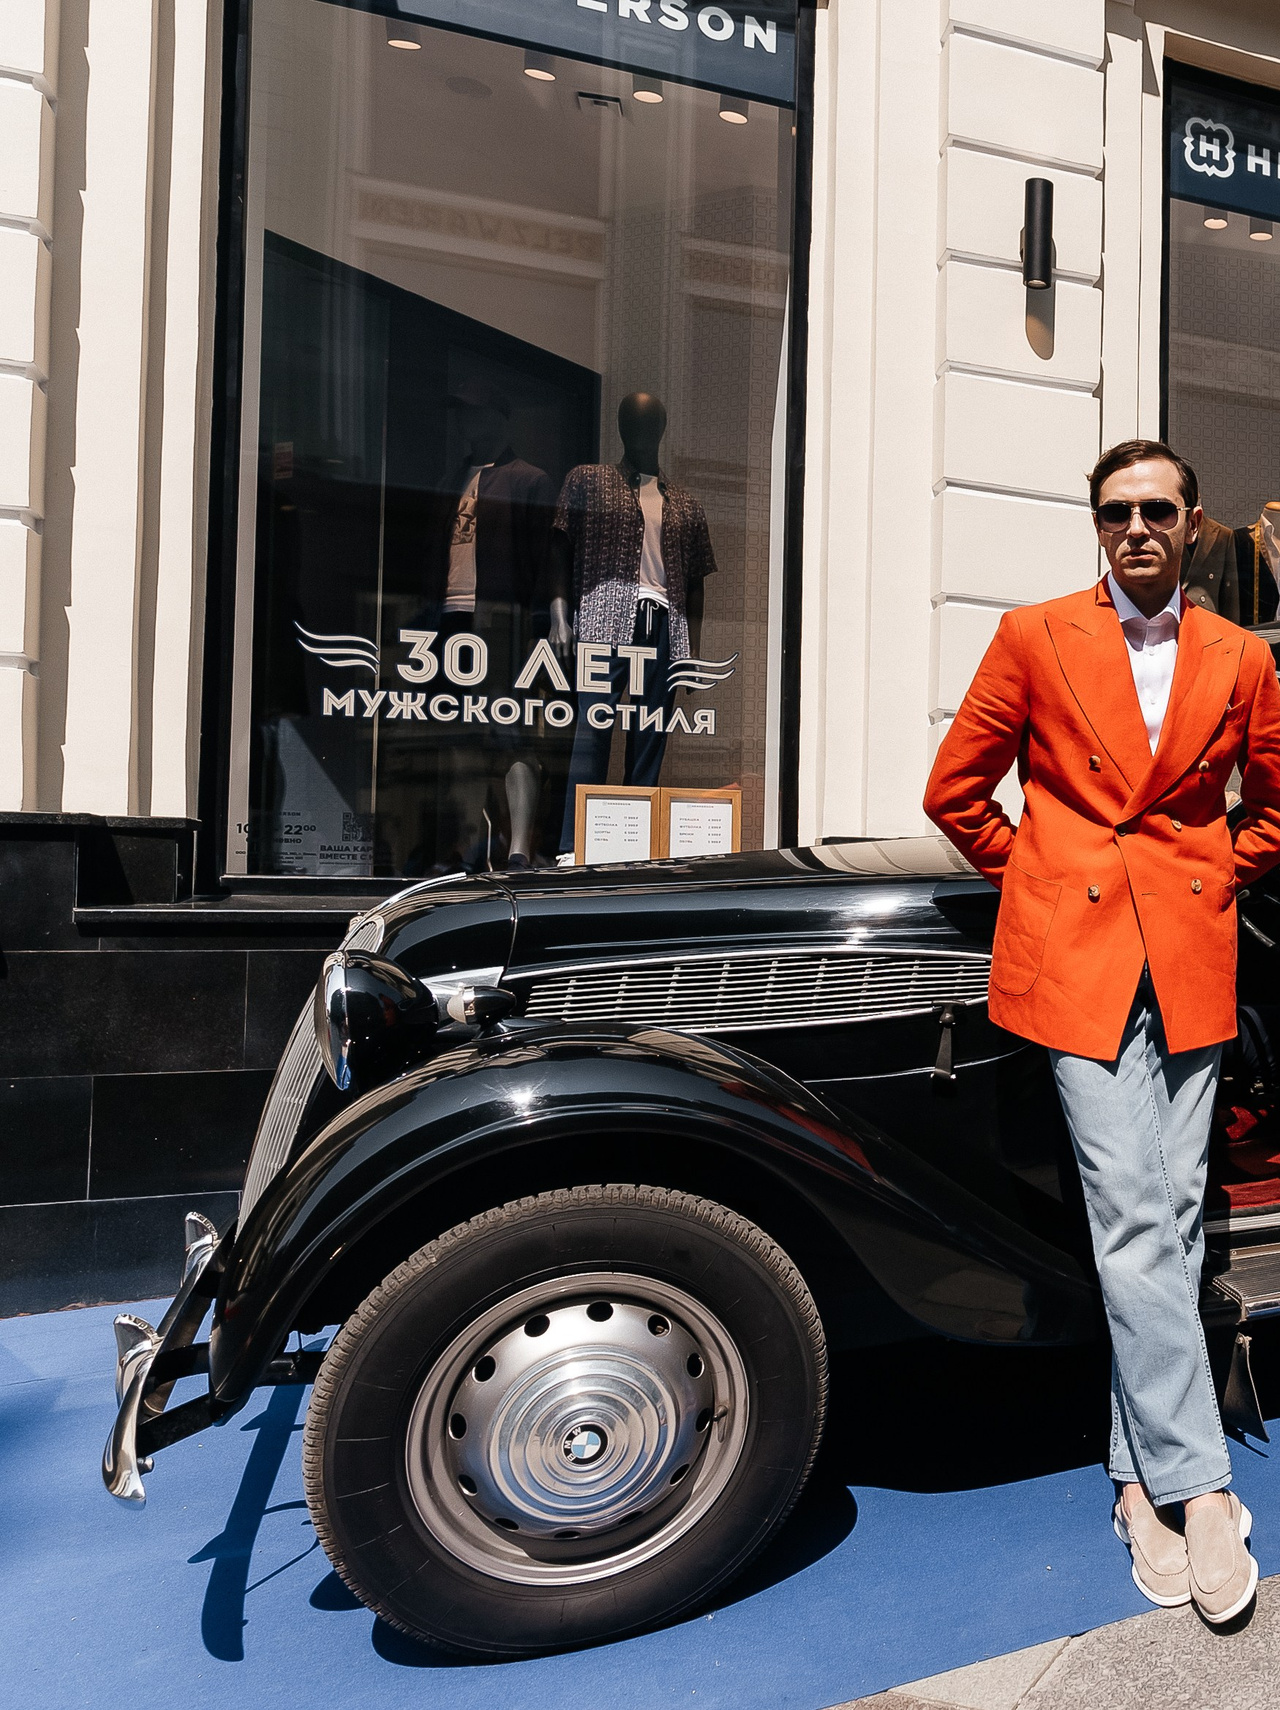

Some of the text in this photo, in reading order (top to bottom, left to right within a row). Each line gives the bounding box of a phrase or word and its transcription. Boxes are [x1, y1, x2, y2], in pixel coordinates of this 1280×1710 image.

[577, 0, 777, 54] RSON
[395, 628, 658, 696] 30 ЛЕТ
[321, 687, 717, 736] МУЖСКОГО СТИЛЯ
[318, 853, 358, 861] ВМЕСТЕ
[319, 845, 350, 853] ВАША
